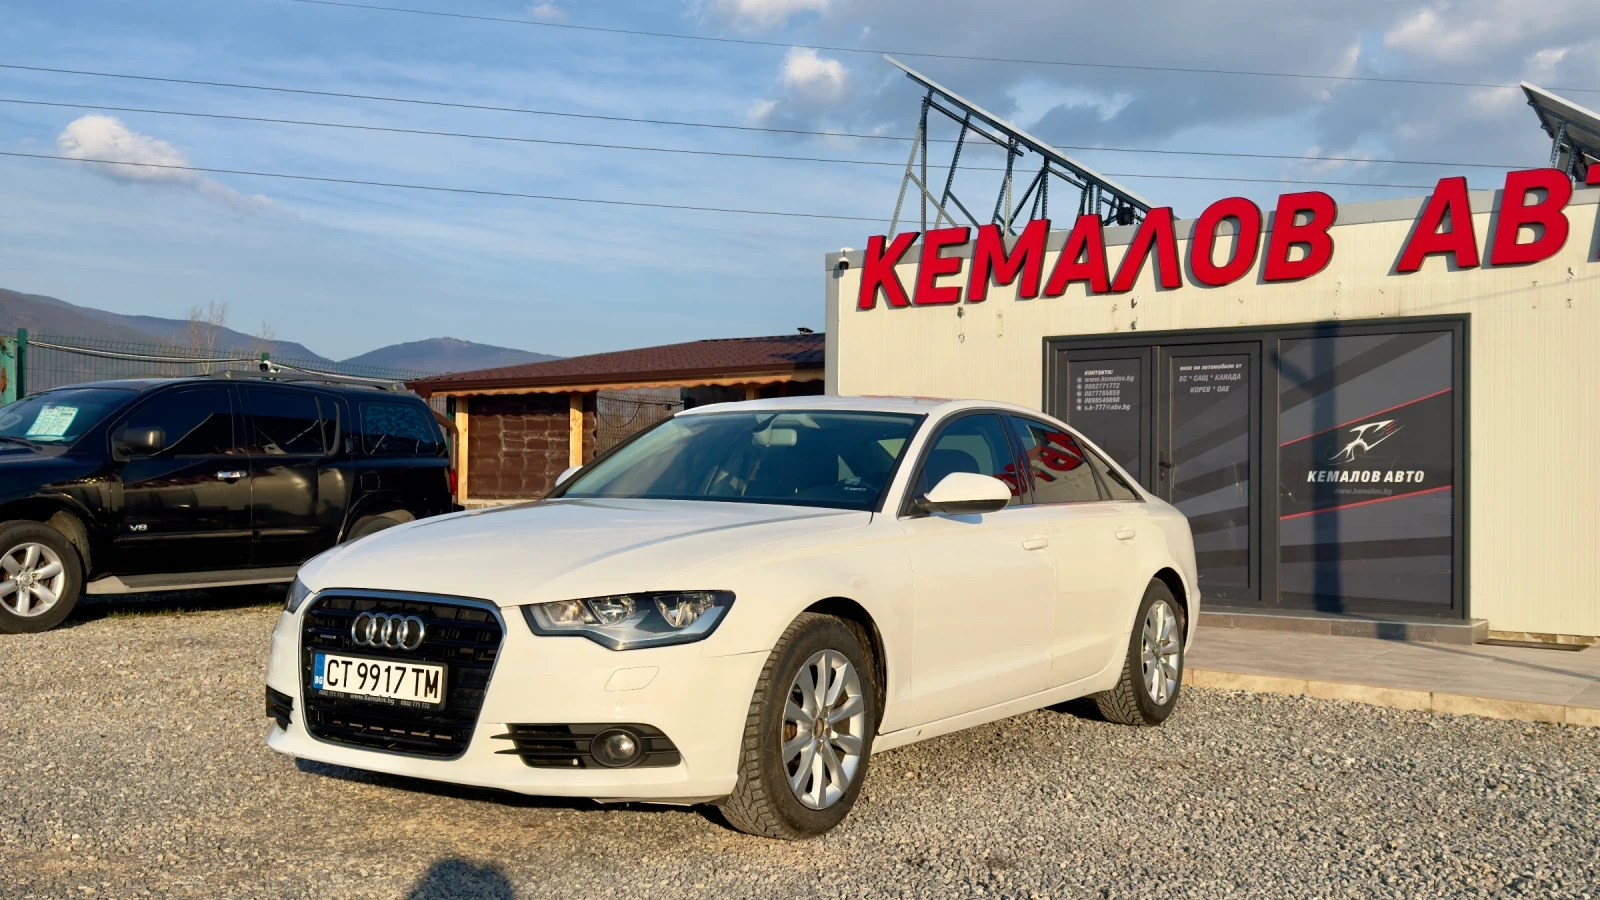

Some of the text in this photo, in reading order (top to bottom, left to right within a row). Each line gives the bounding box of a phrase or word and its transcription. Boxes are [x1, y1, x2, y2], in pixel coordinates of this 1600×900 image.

[858, 163, 1600, 309] КЕМАЛОВ АВ
[1084, 375, 1134, 383] www.kemalov.bg
[1215, 373, 1241, 381] КАНАДА
[1307, 470, 1424, 483] КЕМАЛОВ АВТО
[1333, 487, 1392, 496] www.kemalov.bg
[314, 675, 323, 685] BG
[357, 662, 407, 694] 9917
